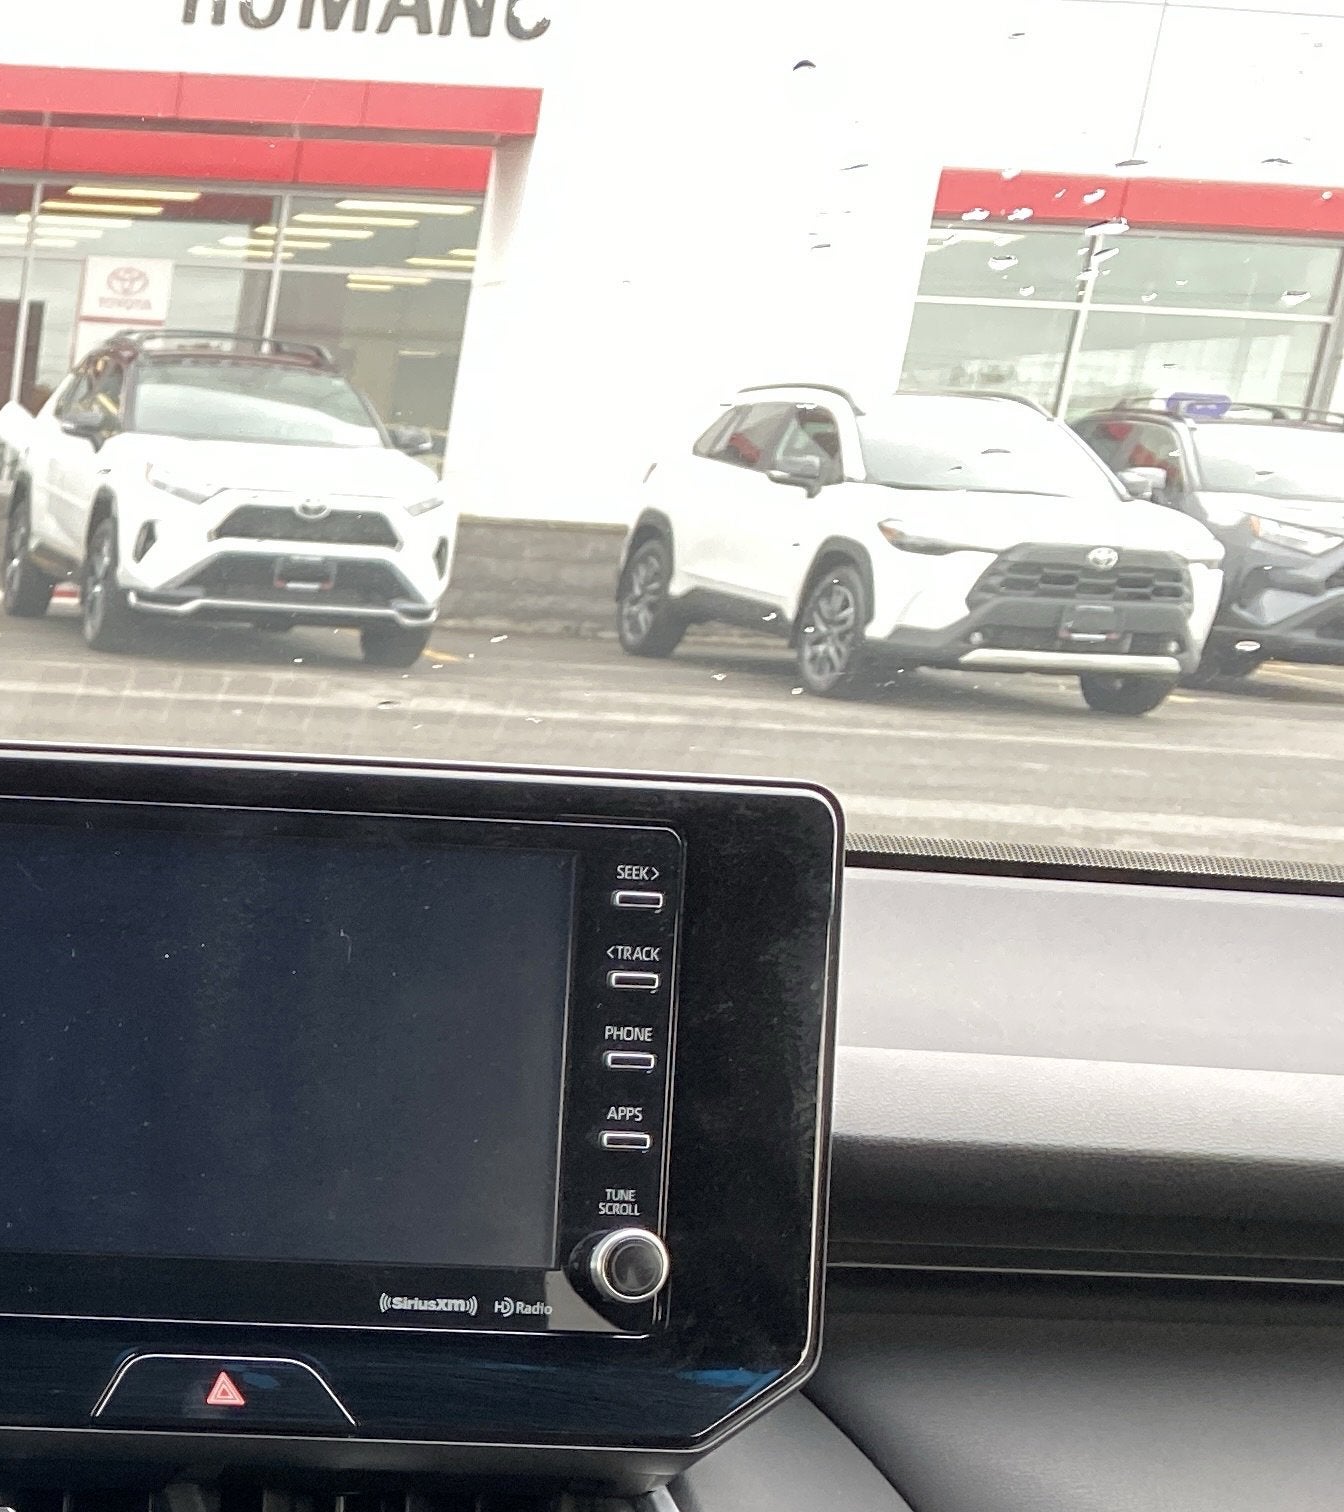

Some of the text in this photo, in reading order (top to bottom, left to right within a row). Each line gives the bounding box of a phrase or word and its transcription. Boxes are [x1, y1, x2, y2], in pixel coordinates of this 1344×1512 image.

[604, 1025, 654, 1043] PHONE
[606, 1106, 644, 1123] APPS
[605, 1189, 637, 1203] TUNE
[598, 1202, 641, 1217] SCROLL
[516, 1301, 553, 1315] Radio
